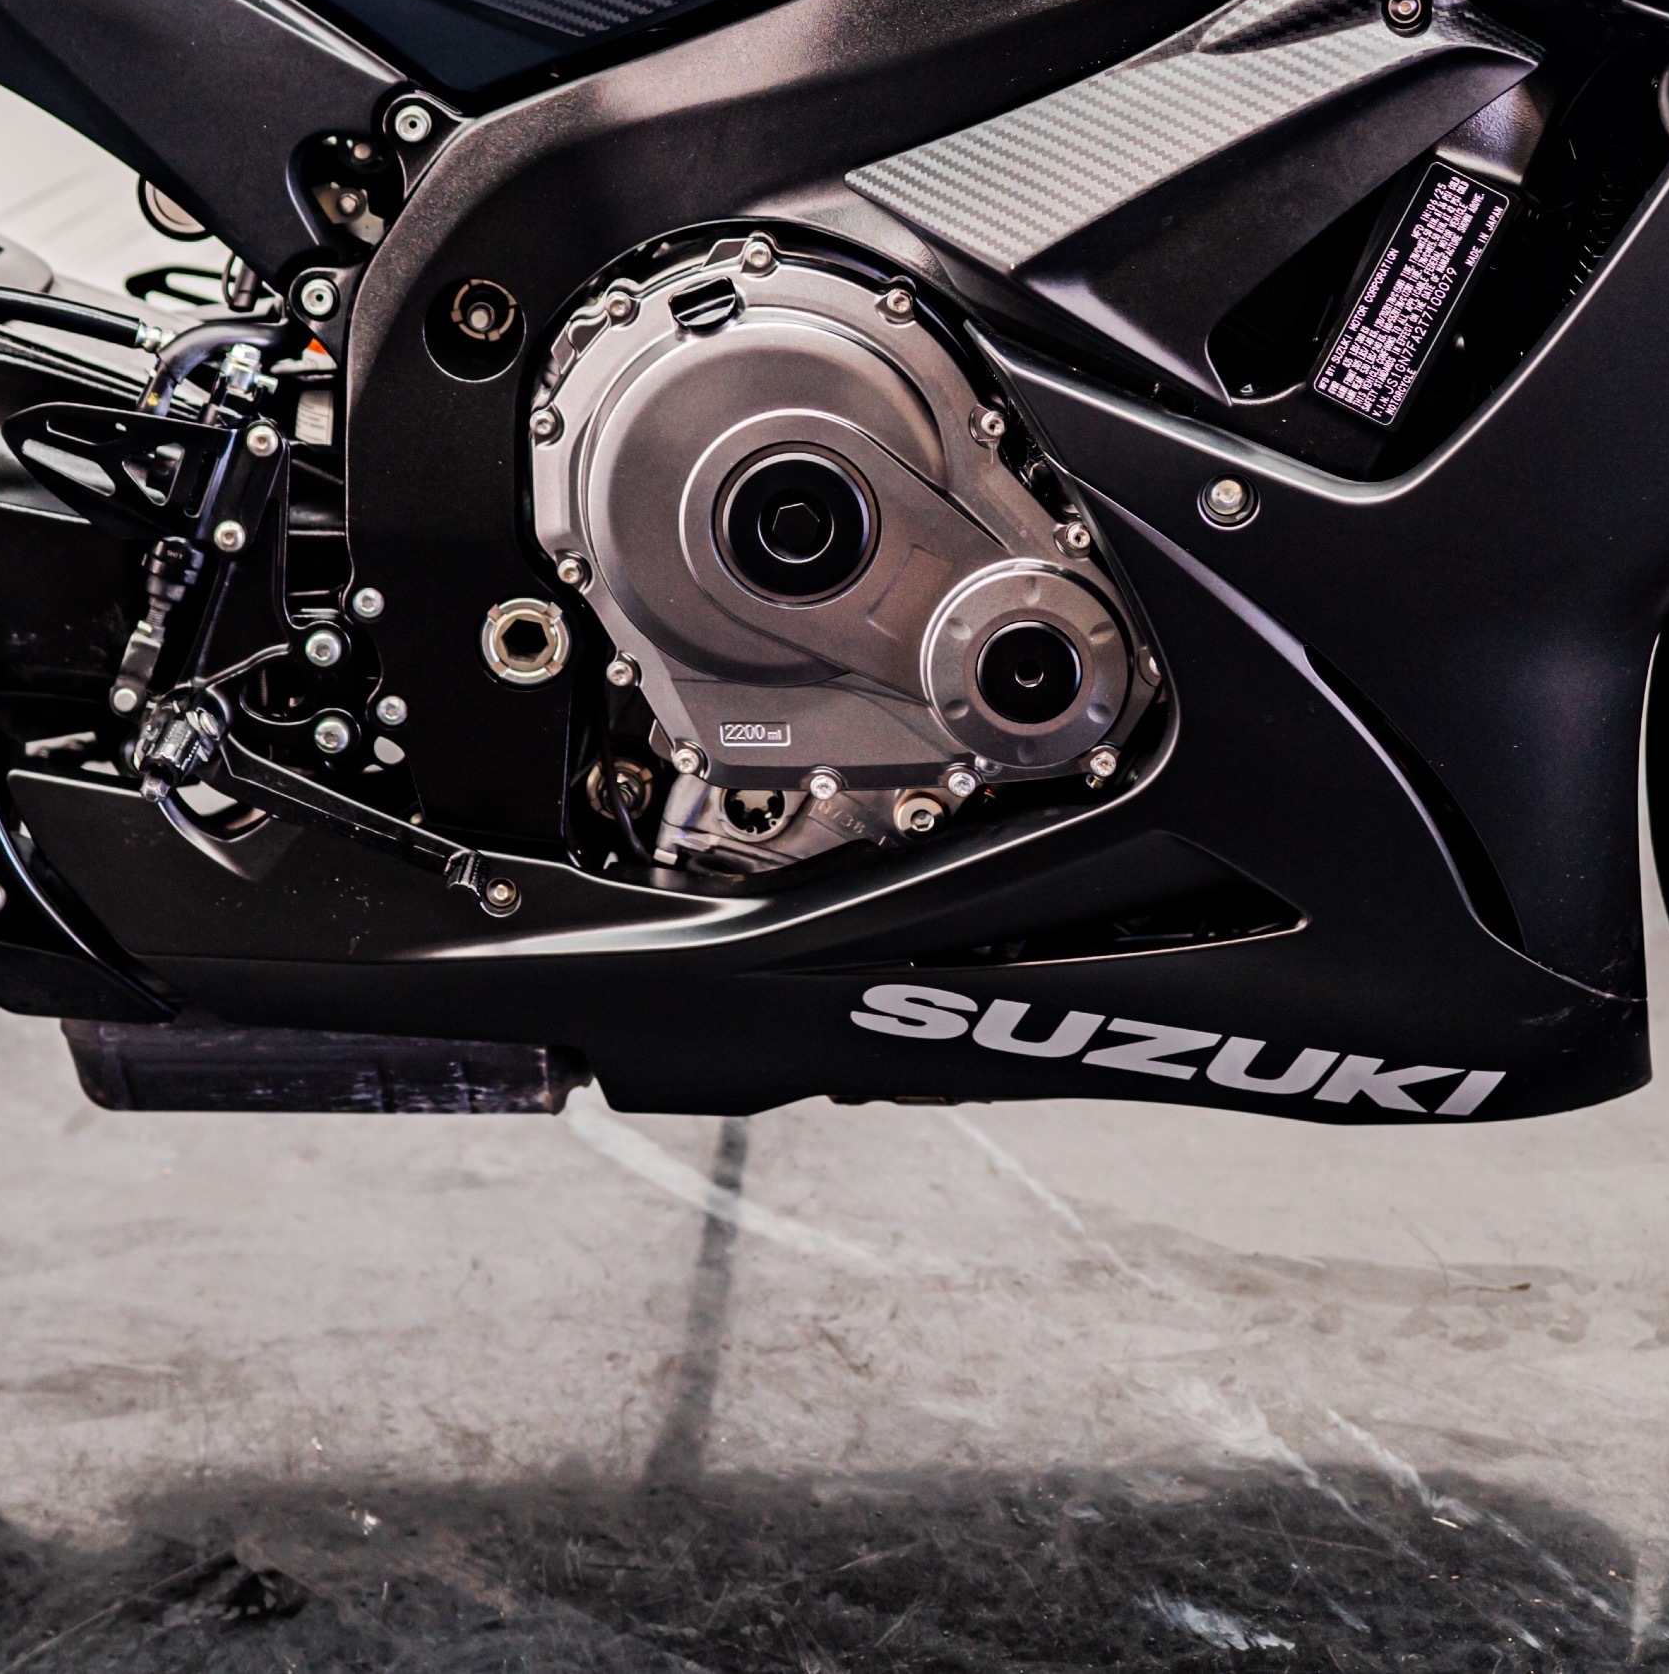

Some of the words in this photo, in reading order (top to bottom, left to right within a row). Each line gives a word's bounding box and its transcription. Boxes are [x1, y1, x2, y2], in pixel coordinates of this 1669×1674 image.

[1411, 224, 1426, 241] MFD
[1456, 213, 1473, 233] SHOWN
[1465, 245, 1483, 268] MADE
[1477, 232, 1491, 245] IN
[1485, 206, 1505, 233] JAPAN
[1435, 232, 1463, 273] MANUFACTURE
[1430, 273, 1440, 283] OF
[1421, 283, 1436, 300] DATE
[1331, 334, 1353, 364] SUZUKI
[1348, 305, 1369, 332] MOTOR
[1364, 248, 1399, 303] CORPORATION
[1352, 391, 1367, 408] THIS
[1361, 365, 1381, 392] VEHICLE
[1376, 335, 1397, 365] CONFORMS
[1391, 326, 1403, 336] TO
[1397, 314, 1410, 326] ALL
[1404, 275, 1429, 313] APPLICABLE
[1423, 250, 1445, 277] FEDERAL
[1437, 229, 1455, 249] MOTOR
[1448, 202, 1470, 230] VEHICLE
[1413, 299, 1427, 312] THE
[1408, 312, 1420, 323] ON
[1384, 267, 1457, 397] JS1GN7FA2T7100079
[1396, 322, 1414, 346] EFFECT
[1391, 346, 1402, 355] IN
[1373, 356, 1396, 389] STANDARDS
[1361, 389, 1378, 412] SAFETY
[1385, 367, 1418, 417] MOTORCYCLE
[724, 724, 766, 741] 2200
